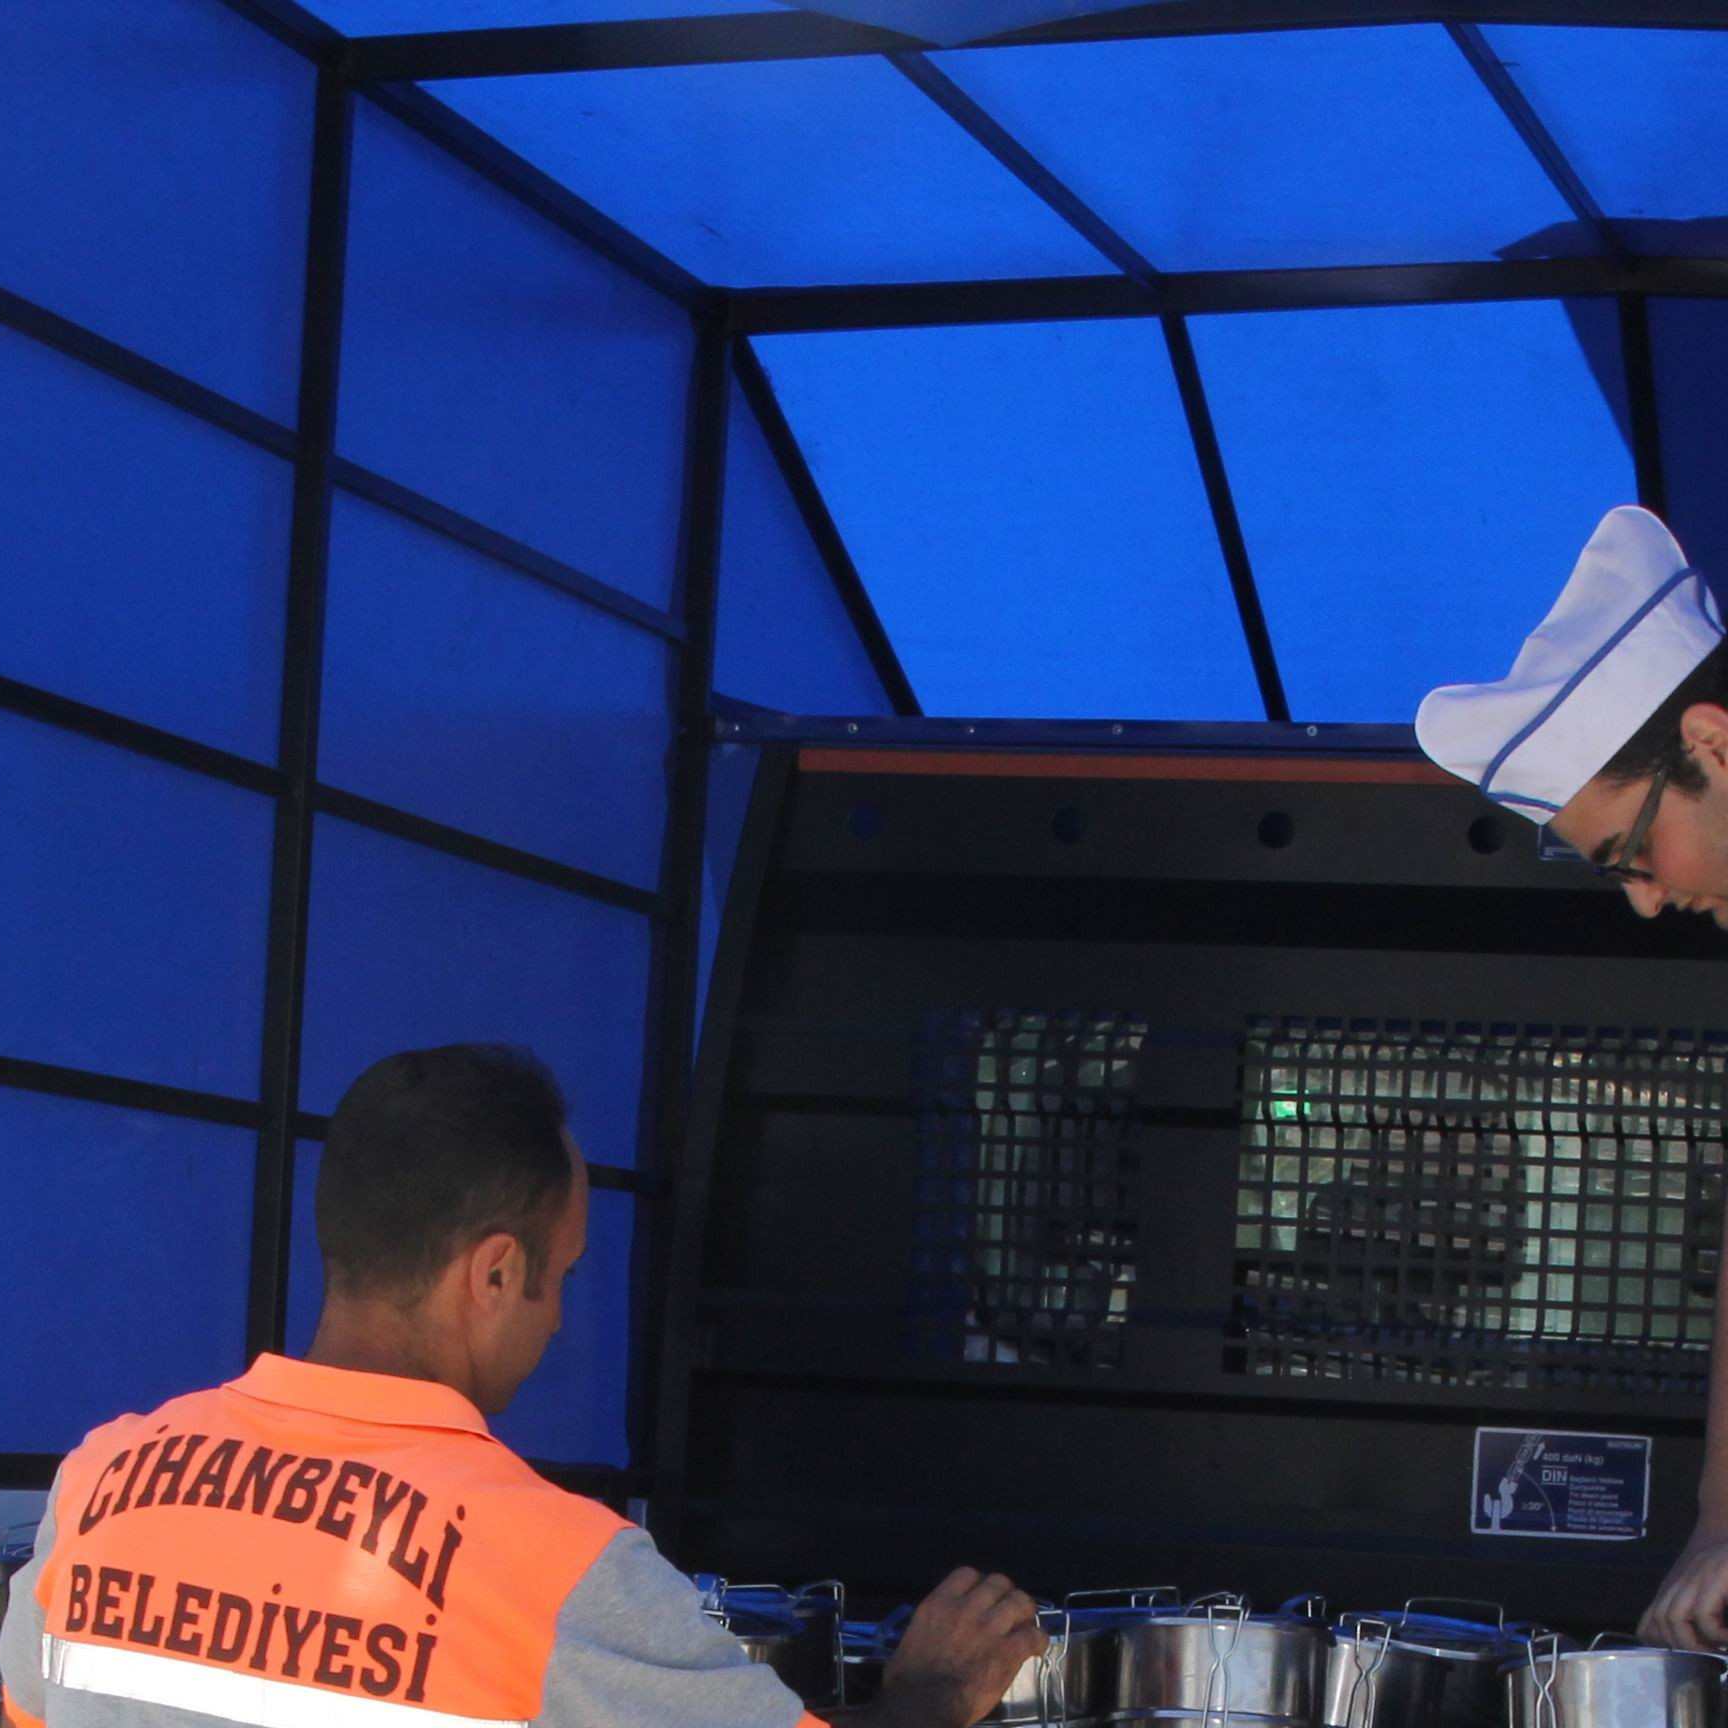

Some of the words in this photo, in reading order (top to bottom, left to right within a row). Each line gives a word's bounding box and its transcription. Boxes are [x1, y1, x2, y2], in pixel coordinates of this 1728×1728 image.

[78, 1424, 466, 1612] CİHANBEYLİ
[1541, 1468, 1568, 1483] DIN
[65, 1564, 439, 1704] BELEDİYESİ
